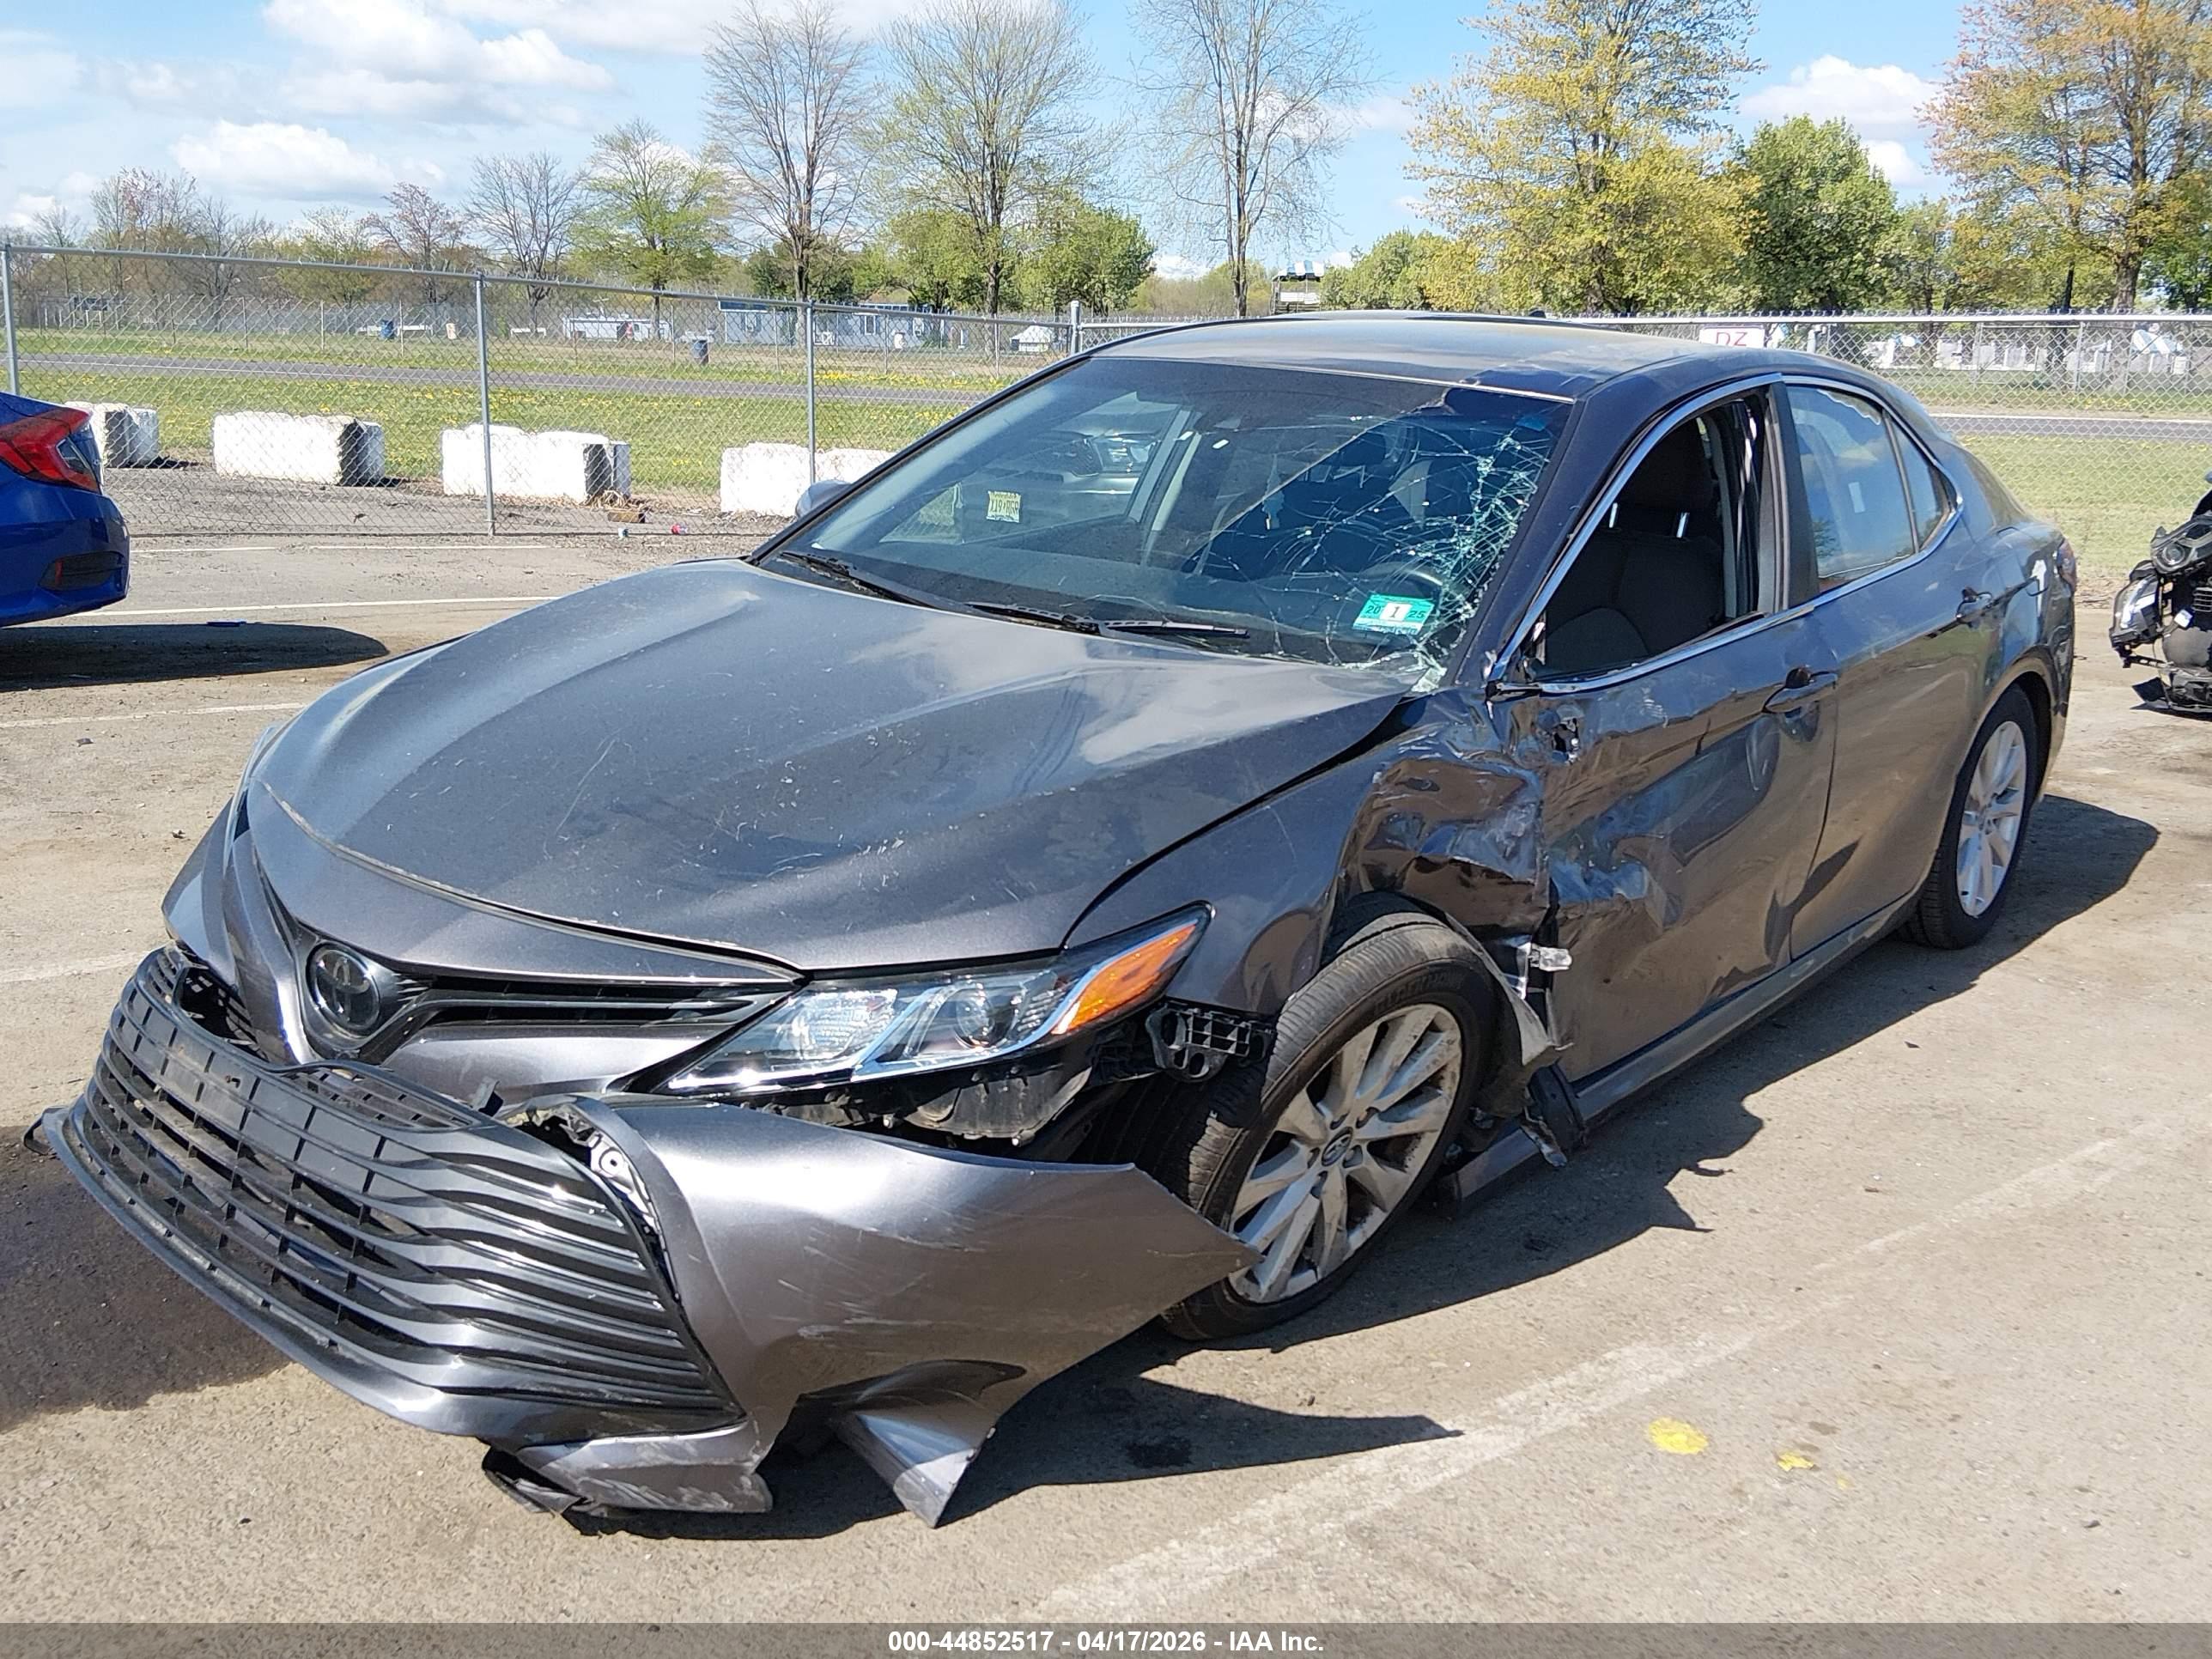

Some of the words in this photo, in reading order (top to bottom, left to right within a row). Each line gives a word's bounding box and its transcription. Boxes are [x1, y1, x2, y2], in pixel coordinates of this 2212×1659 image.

[1365, 605, 1382, 615] 20
[1389, 605, 1401, 619] 1
[1407, 610, 1425, 619] 25
